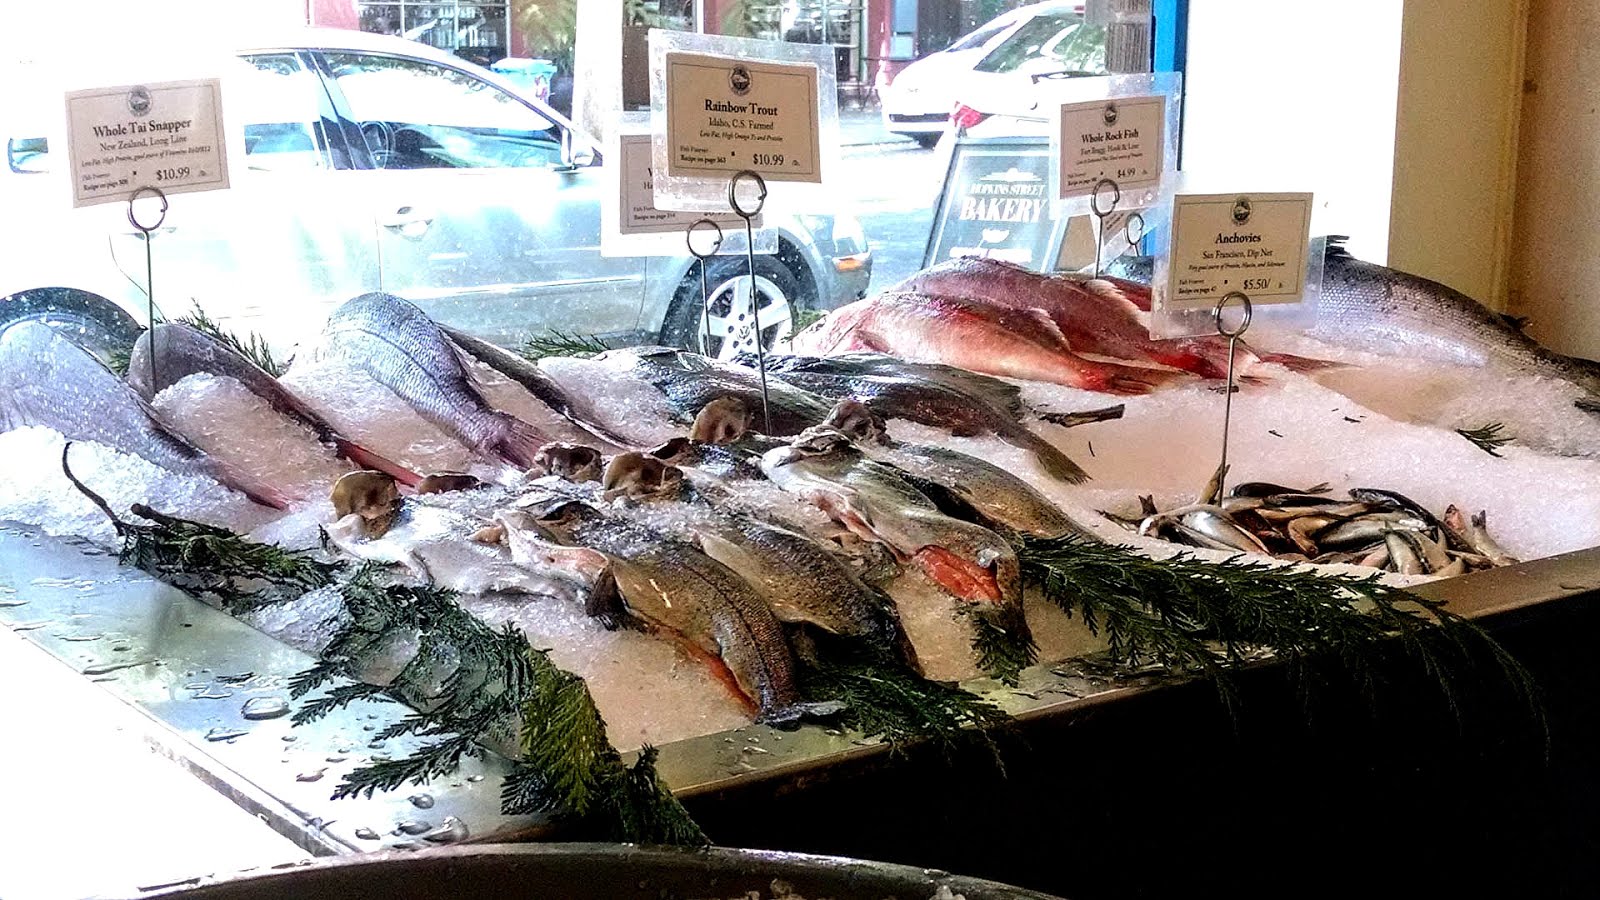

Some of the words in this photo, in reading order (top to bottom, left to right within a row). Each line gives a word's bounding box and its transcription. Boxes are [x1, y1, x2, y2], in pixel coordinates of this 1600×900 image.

[705, 99, 747, 113] Rainbow
[749, 102, 778, 116] Trout
[93, 124, 128, 137] Whole
[128, 121, 147, 134] Tai
[148, 119, 192, 133] Snapper
[709, 117, 731, 128] Idaho,
[749, 120, 774, 130] Farmed
[1081, 132, 1104, 143] Whole
[1105, 130, 1122, 141] Rock
[1123, 128, 1139, 139] Fish
[100, 142, 116, 151] New
[118, 138, 148, 150] Zealand,
[170, 135, 187, 144] Line
[753, 153, 784, 166] $10.99
[156, 166, 190, 181] $10.99
[1117, 167, 1136, 178] $4.99
[960, 196, 1048, 223] BAKERY
[1214, 232, 1262, 244] Anchovies
[1203, 251, 1214, 260] San
[1215, 250, 1245, 259] Francisco,
[1243, 278, 1272, 291] $5.50/
